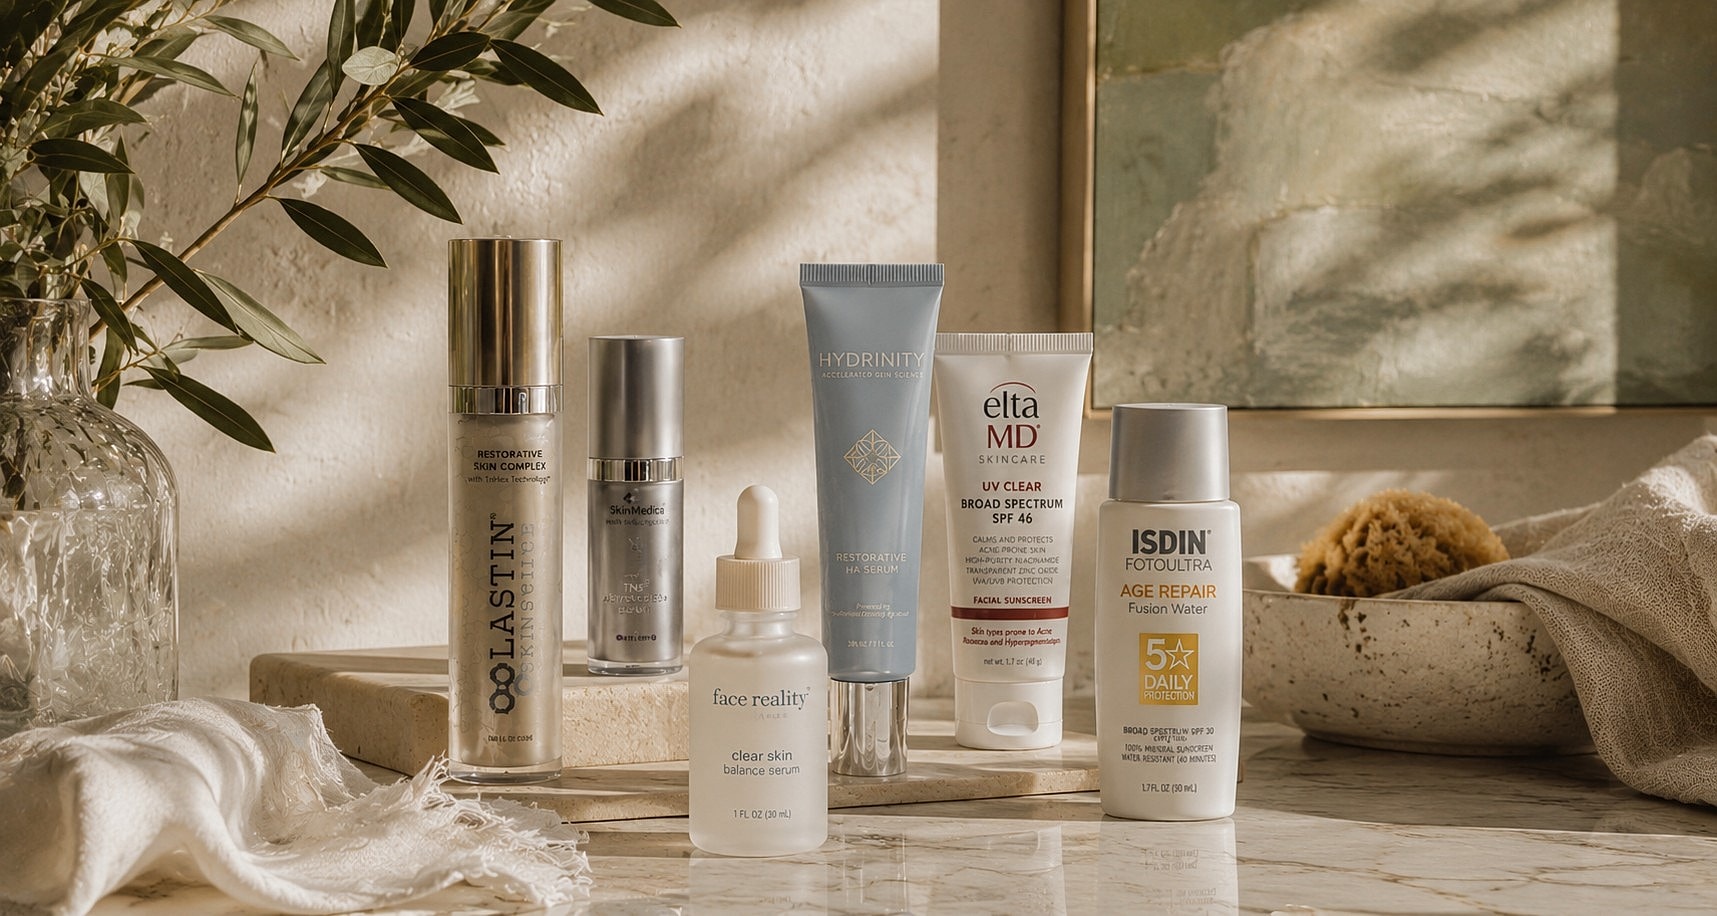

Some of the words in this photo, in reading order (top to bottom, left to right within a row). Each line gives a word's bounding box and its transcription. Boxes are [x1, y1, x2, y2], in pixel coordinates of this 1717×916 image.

[819, 352, 925, 368] HYDRINITY
[983, 391, 1039, 419] elta
[477, 449, 543, 459] RESTORATIVE
[978, 454, 1046, 465] SKINCARE
[473, 462, 497, 471] SKIN
[500, 462, 547, 471] COMPLEX
[982, 481, 1000, 492] UV
[1003, 481, 1042, 492] CLEAR
[961, 499, 1001, 509] BROAD
[1004, 499, 1063, 509] SPECTRUM
[992, 513, 1014, 524] SPF
[1018, 513, 1033, 524] 46
[999, 536, 1016, 544] AND
[1017, 536, 1054, 544] PROTECTS
[836, 552, 908, 562] RESTORATIVE
[845, 565, 861, 574] HA
[863, 565, 899, 574] SERUM
[1125, 557, 1213, 572] FOTOULTRA
[1120, 583, 1154, 598] AGE
[1159, 584, 1217, 599] REPAIR
[973, 596, 1001, 605] FACIAL
[1004, 596, 1052, 605] SUNSCREEN
[1128, 601, 1168, 615] Fusion
[1171, 603, 1208, 615] Water
[1144, 674, 1193, 690] DAILY
[713, 687, 748, 706] face
[752, 689, 809, 710] reality
[1143, 690, 1195, 700] PROTECTION
[731, 750, 763, 761] clear
[767, 750, 793, 761] skin
[723, 763, 766, 776] balance
[768, 765, 801, 776] serum
[739, 809, 749, 819] FL
[751, 809, 763, 819] OZ
